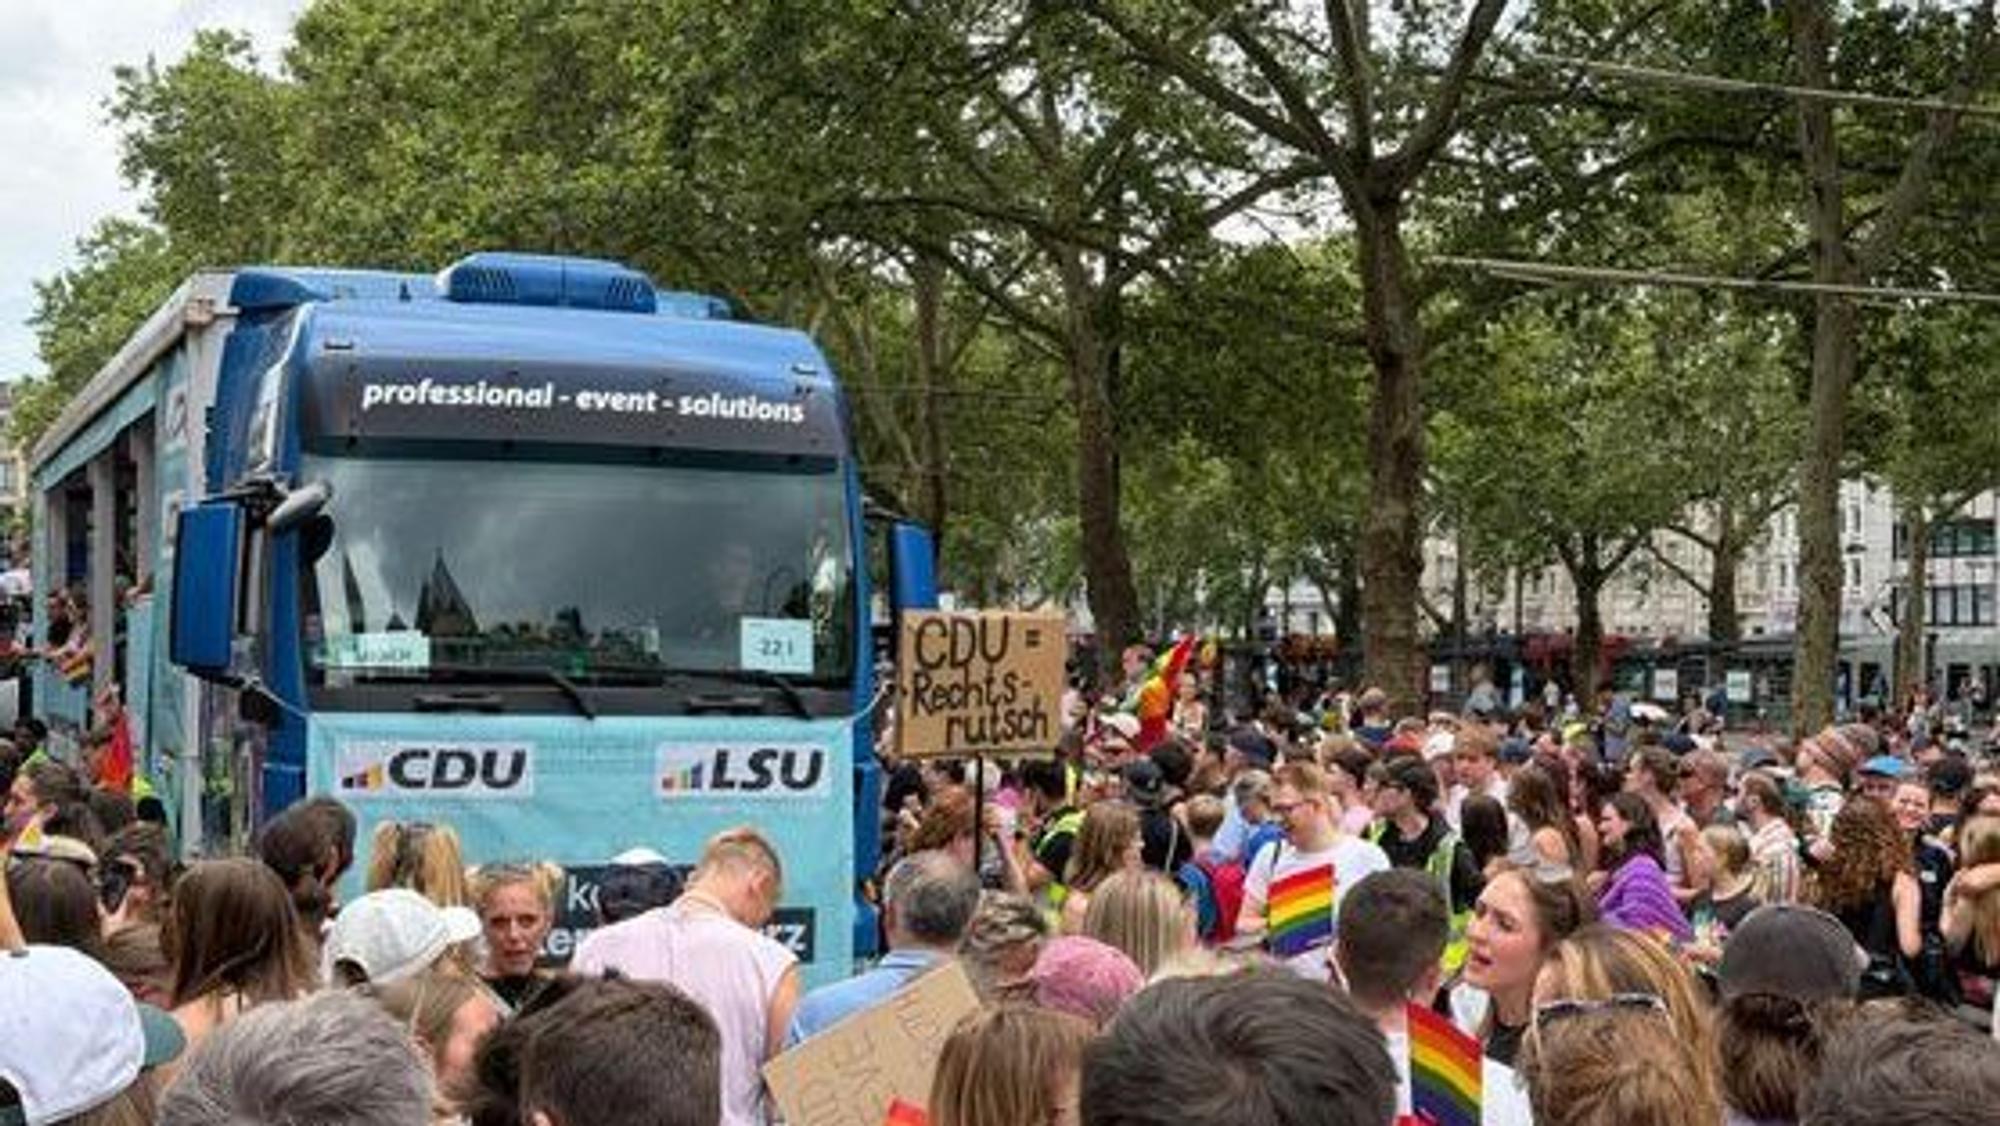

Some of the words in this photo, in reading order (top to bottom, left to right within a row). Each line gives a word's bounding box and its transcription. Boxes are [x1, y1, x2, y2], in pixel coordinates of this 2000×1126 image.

[361, 378, 555, 411] professional
[575, 389, 659, 412] event
[677, 391, 804, 423] solutions
[915, 615, 1009, 670] CDU
[912, 665, 1033, 718] Rechts-
[946, 694, 1049, 749] rutsch
[388, 748, 526, 790] CDU
[709, 748, 824, 790] LSU
